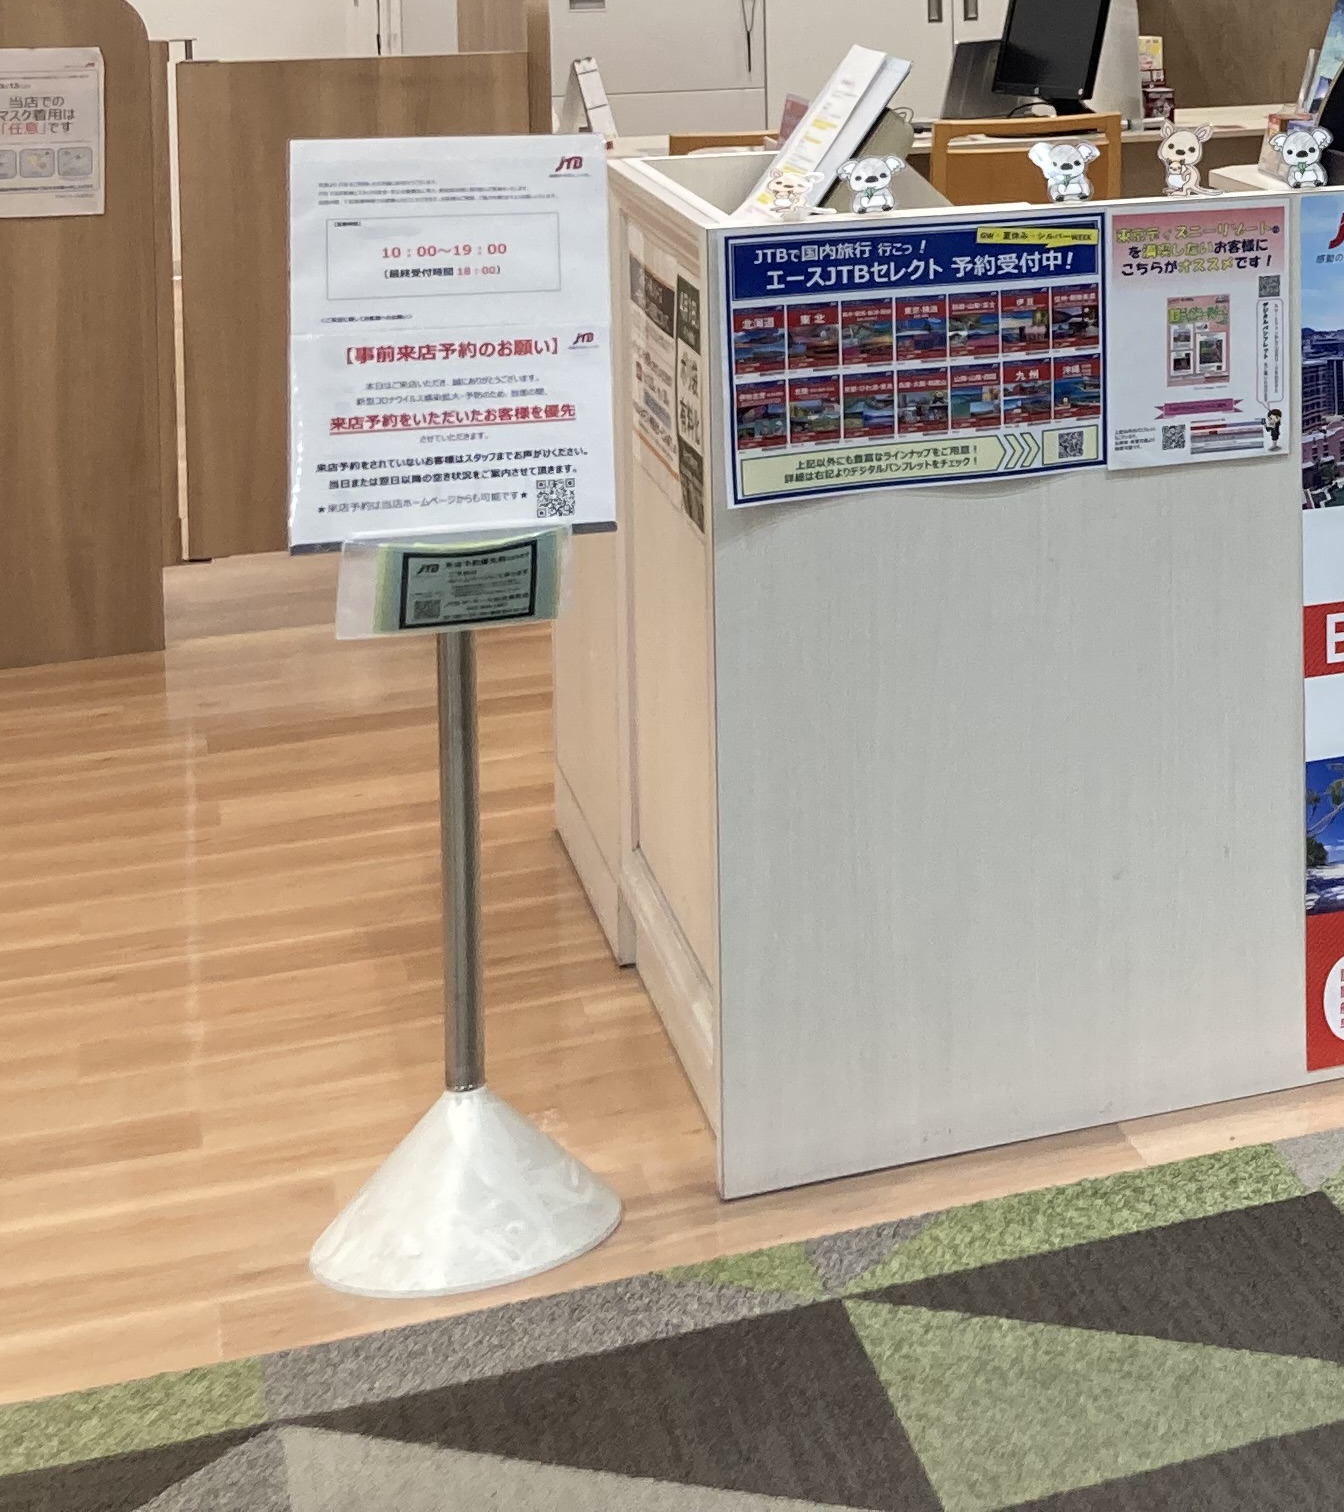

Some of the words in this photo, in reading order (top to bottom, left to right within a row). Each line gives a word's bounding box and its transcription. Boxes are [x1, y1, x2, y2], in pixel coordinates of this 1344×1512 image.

[555, 156, 583, 172] JTB
[754, 242, 872, 264] JTBで国内旅行
[766, 258, 944, 290] エースJTBセレクト
[951, 250, 1074, 279] 予約受付中！
[330, 403, 576, 431] 来店予約をいただいたお客様を優先
